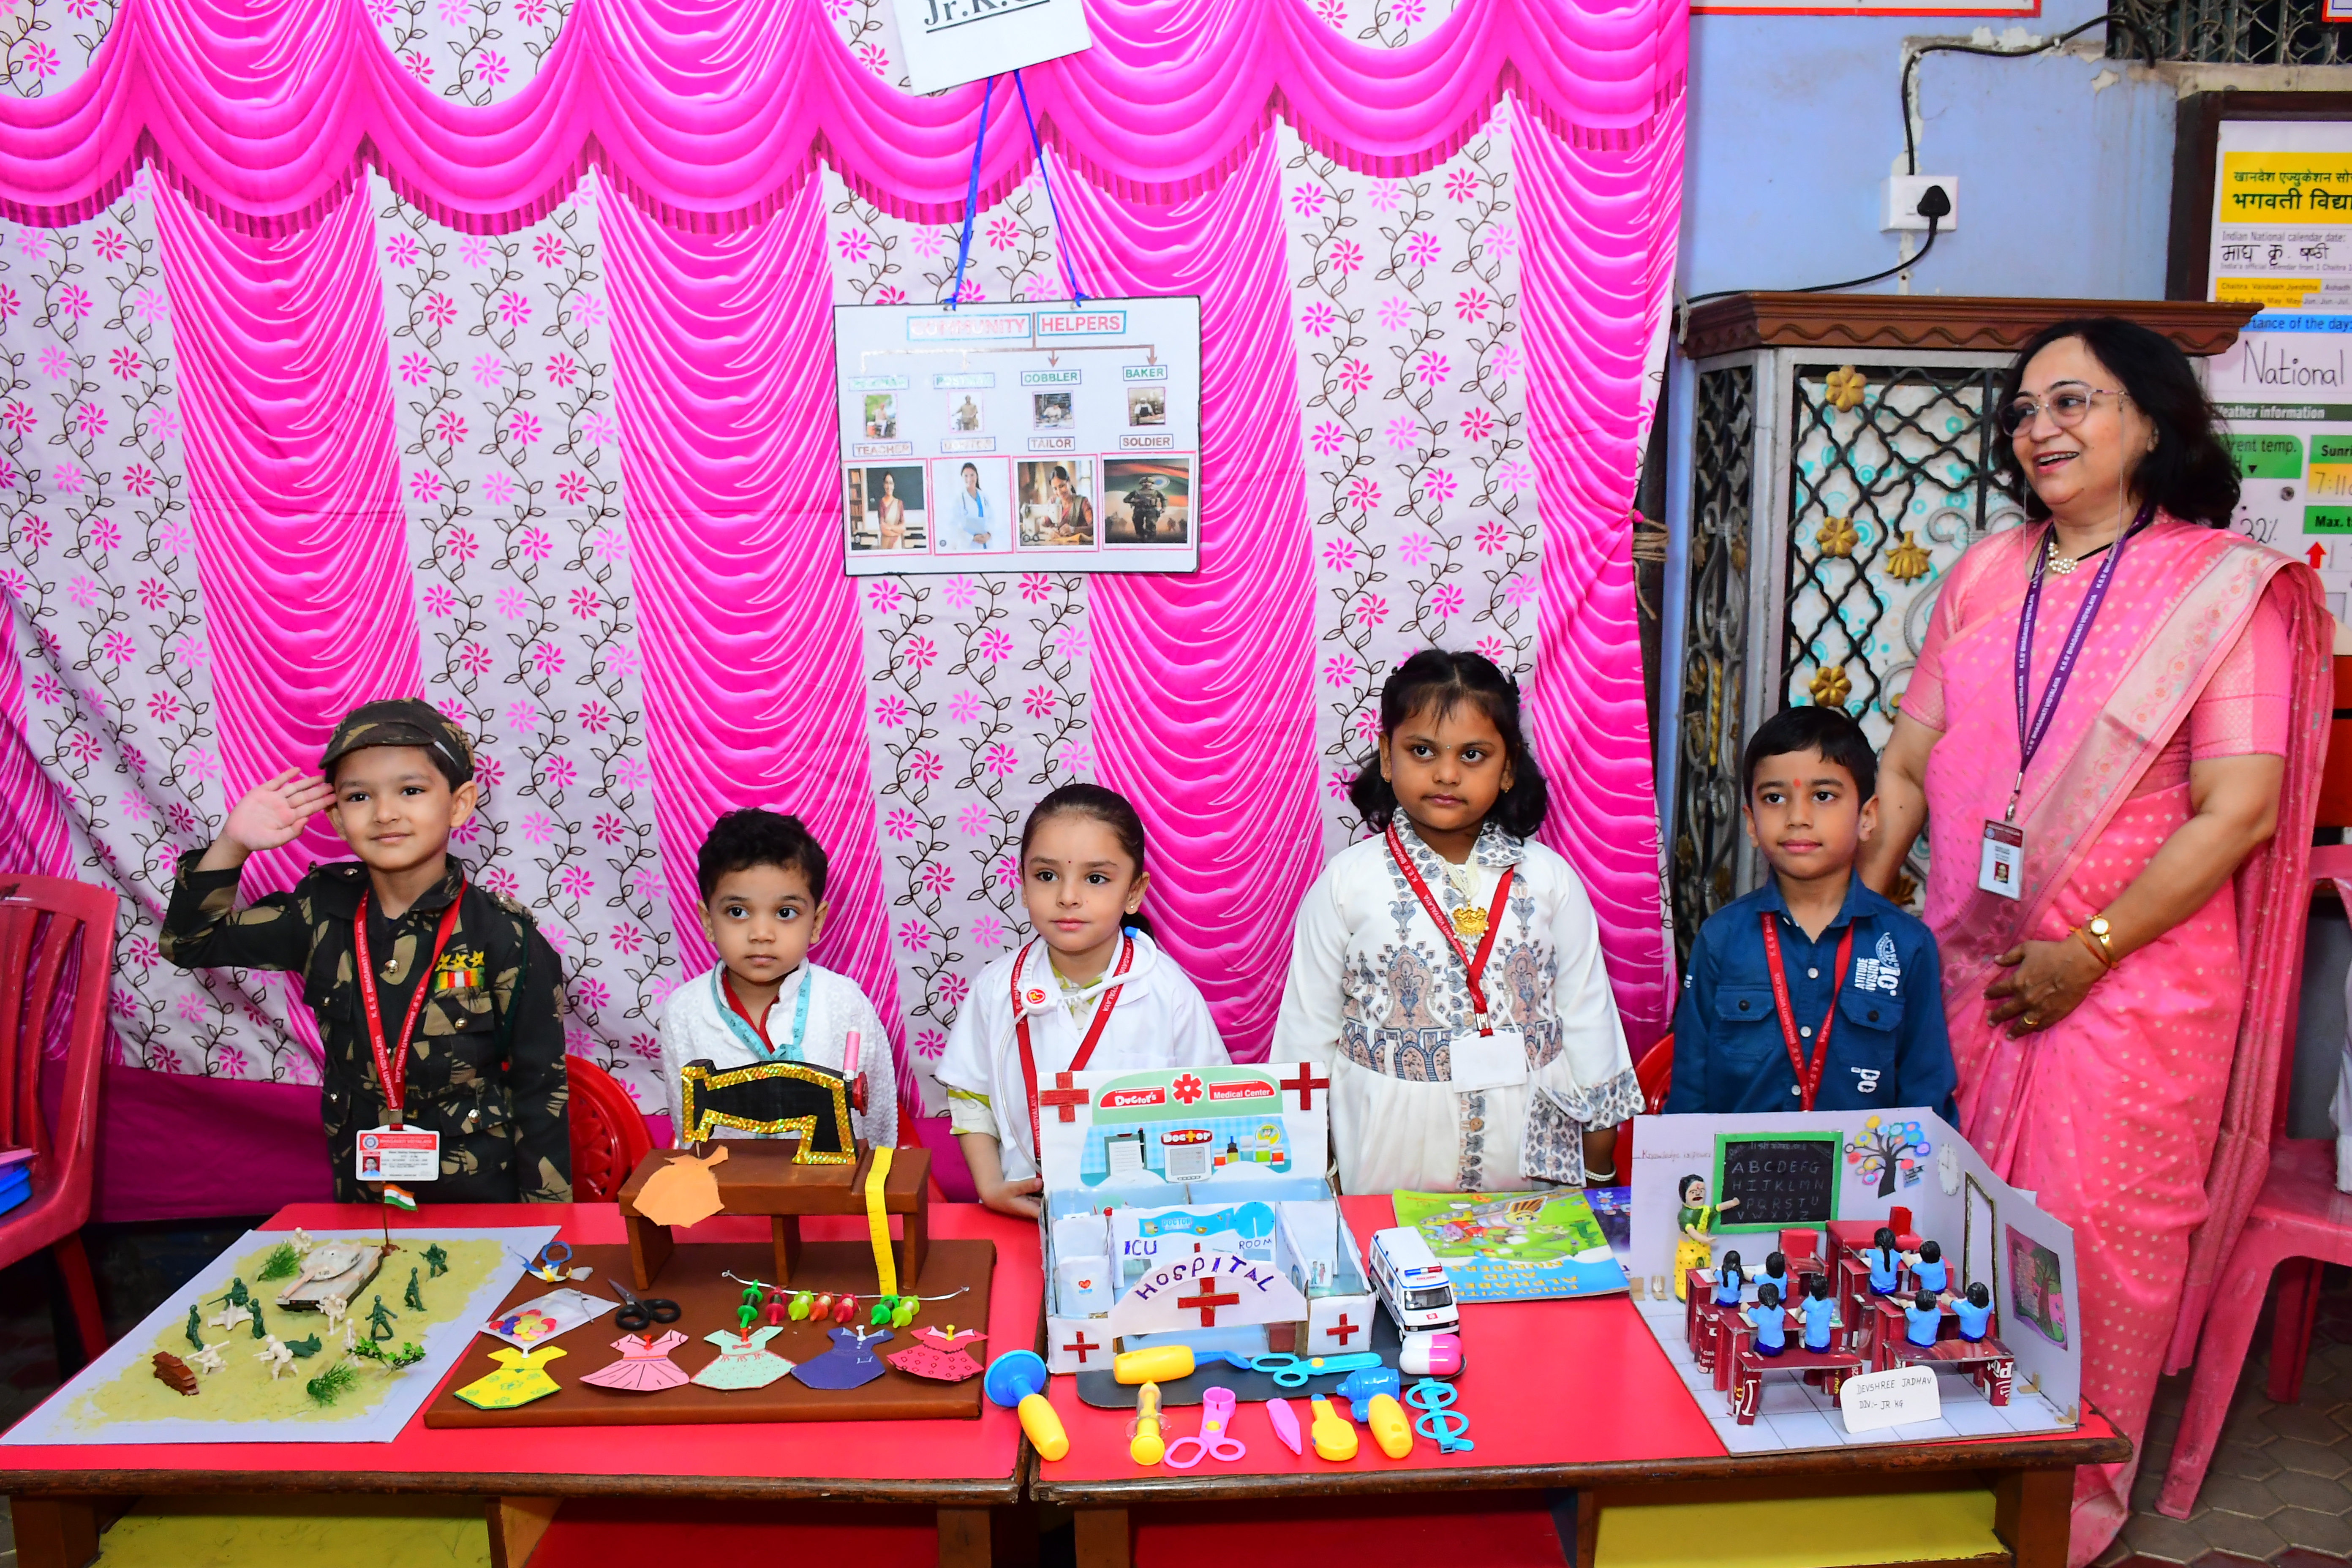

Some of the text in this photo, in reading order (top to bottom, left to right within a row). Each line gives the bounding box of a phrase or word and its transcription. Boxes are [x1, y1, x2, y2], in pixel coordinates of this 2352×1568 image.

[2234, 169, 2276, 182] खानदेश
[2233, 188, 2302, 210] भगवती
[2222, 232, 2247, 241] Indian
[2251, 232, 2285, 241] National
[2288, 232, 2322, 242] calendar
[911, 316, 1120, 335] COMMUNITY HELPERS
[2289, 317, 2302, 329] of
[2306, 318, 2324, 329] the
[2243, 340, 2344, 387] National
[1024, 372, 1078, 383] COBBLER
[1125, 368, 1164, 378] BAKER
[2261, 406, 2325, 419] information
[1031, 438, 1071, 449] TAILOR
[1123, 437, 1170, 446] SOLDIER
[2262, 439, 2297, 455] temp.
[856, 444, 909, 455] TEACHER
[2315, 516, 2343, 528] Max.
[1423, 893, 1445, 927] VIDYALAYA
[1118, 946, 1132, 975] BHAGAVA
[1214, 1088, 1271, 1099] Medical Center
[1030, 1094, 1040, 1130] VIDYALAYA
[1162, 1217, 1192, 1226] DOCTOR
[1124, 1238, 1272, 1256] ICU ROOM
[1452, 1260, 1563, 1273] NUMBERS
[1135, 1255, 1274, 1300] HOSPITAL
[1483, 1271, 1536, 1280] AND
[1452, 1276, 1578, 1289] ALPHABET
[1516, 1284, 1579, 1295] ENJOY
[1857, 1377, 1932, 1395] DEVSHREE JADHAV
